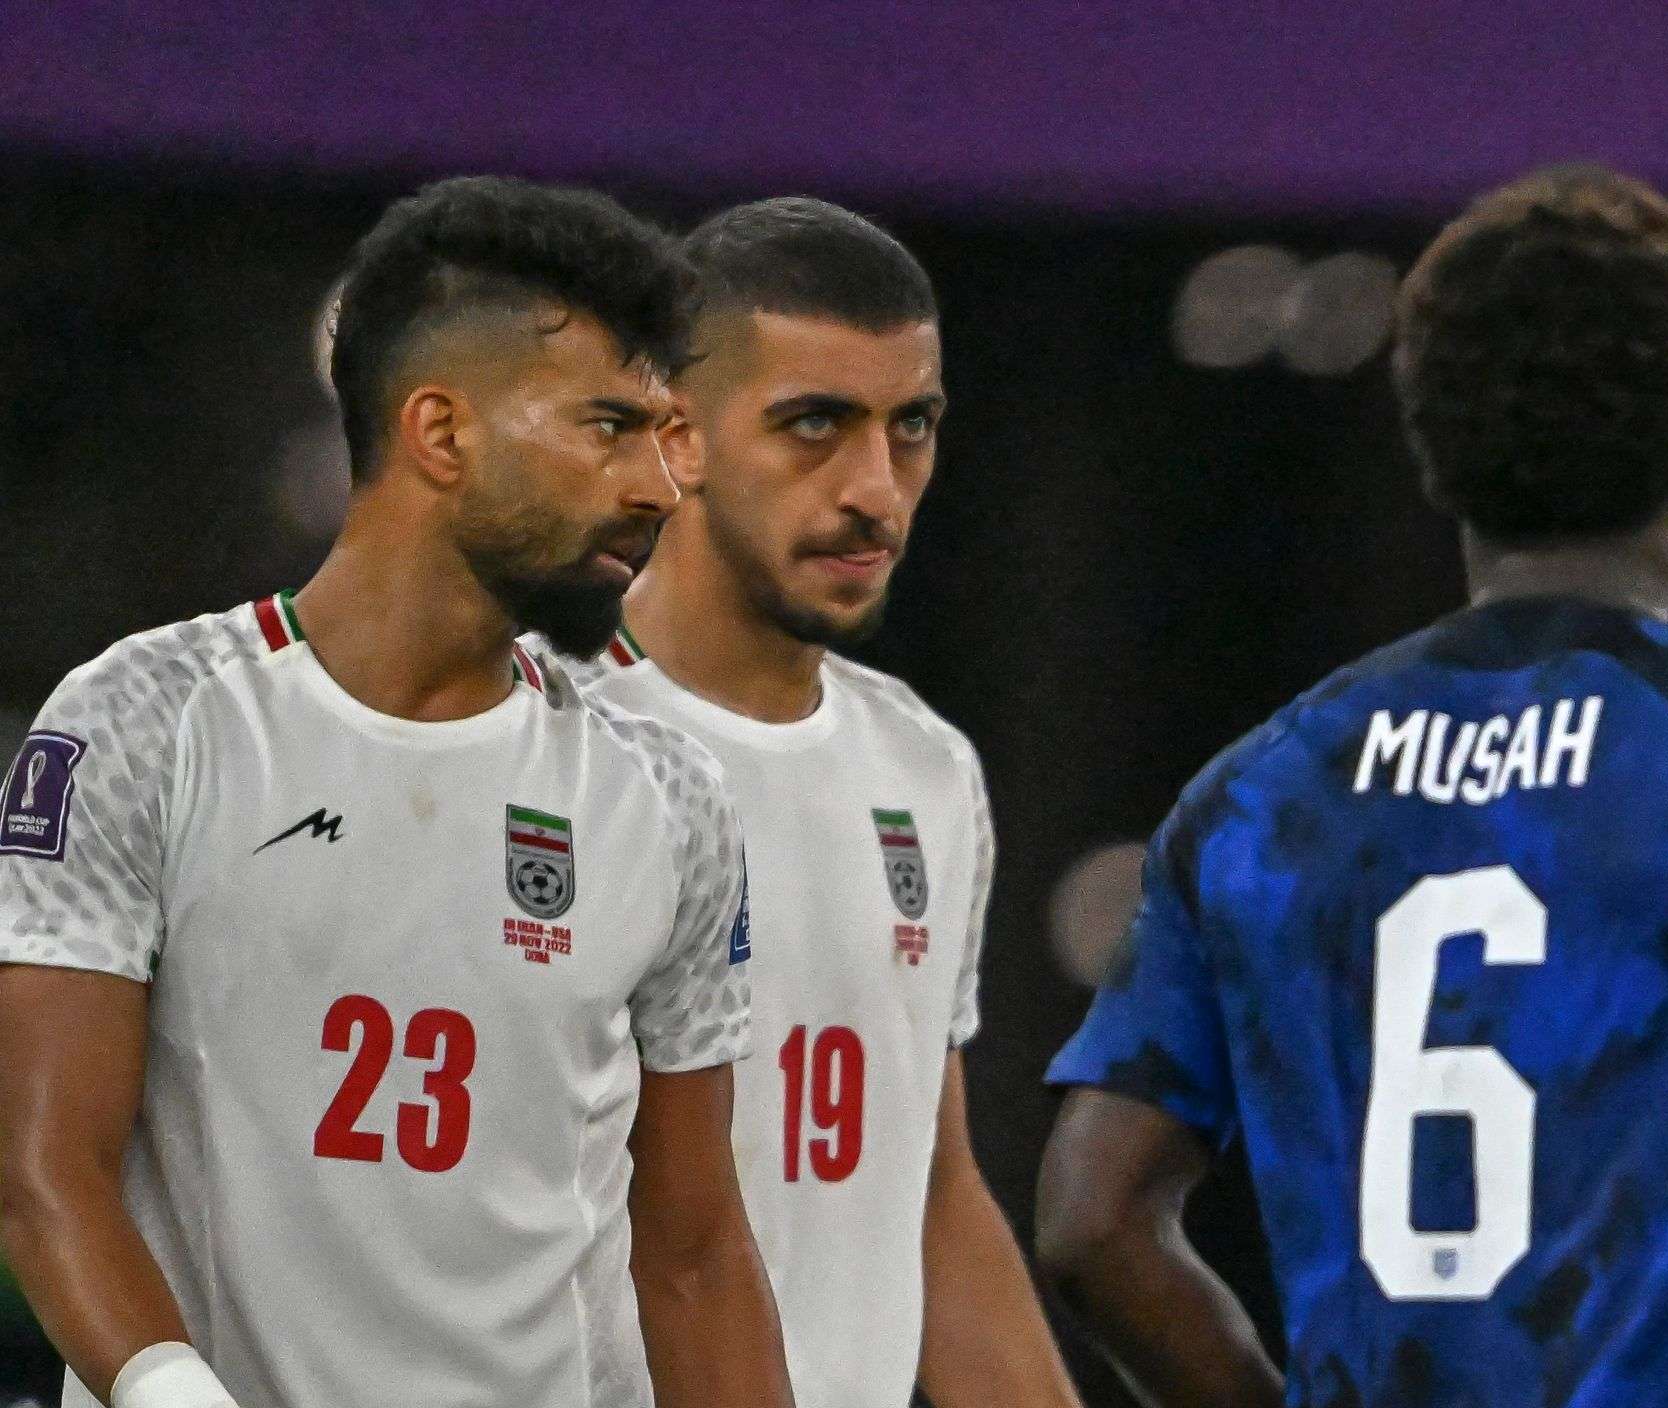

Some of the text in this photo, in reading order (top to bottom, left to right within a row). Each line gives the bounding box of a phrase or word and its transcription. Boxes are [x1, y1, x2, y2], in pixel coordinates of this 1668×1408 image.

[1353, 695, 1604, 805] MUSAH
[312, 994, 477, 1174] 23
[777, 1024, 867, 1183] 19
[1359, 864, 1549, 1302] 6
